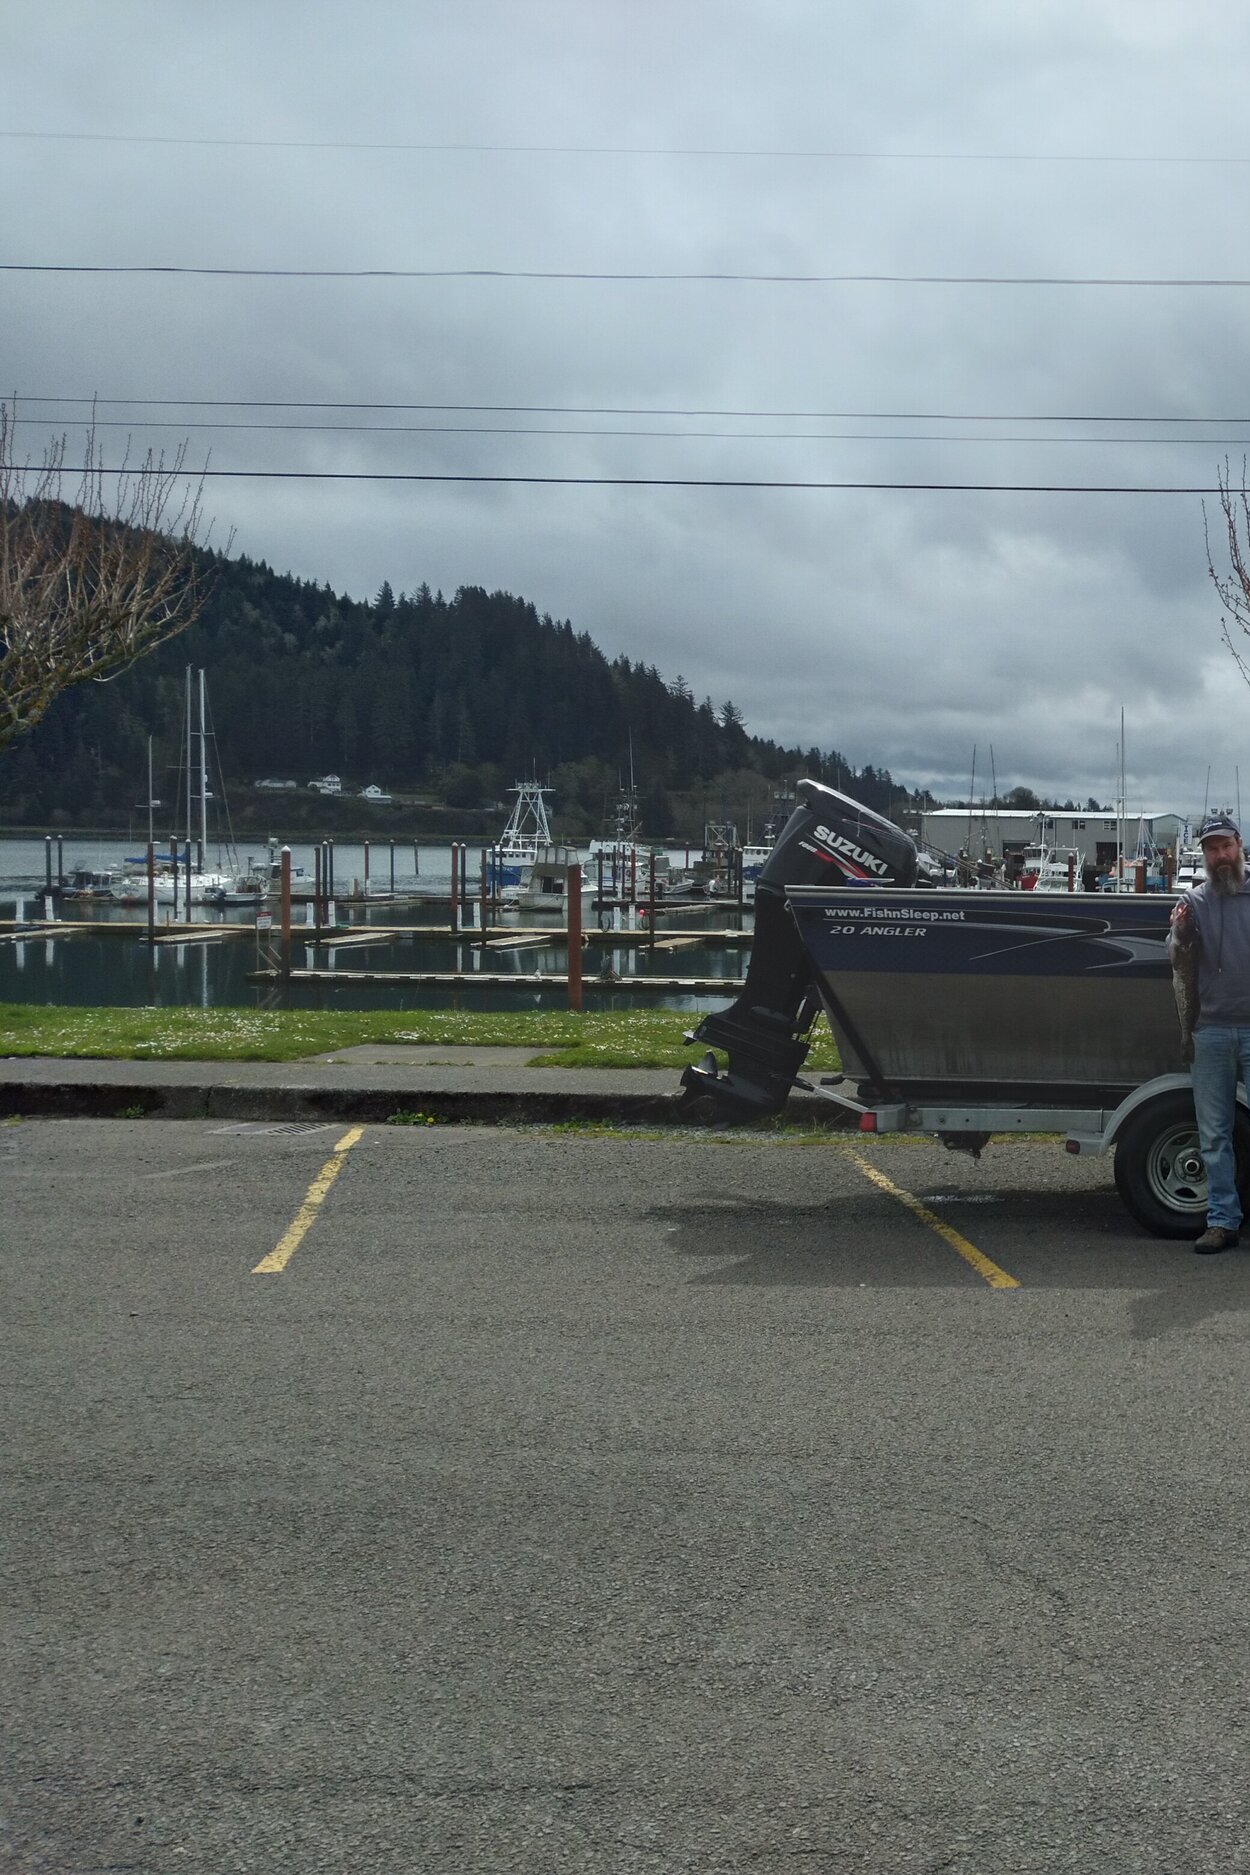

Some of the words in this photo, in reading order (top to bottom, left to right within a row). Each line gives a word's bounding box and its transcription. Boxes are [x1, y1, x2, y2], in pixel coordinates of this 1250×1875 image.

[814, 825, 889, 875] SUZUKI
[825, 907, 965, 921] www.FishnSleep.net
[830, 925, 855, 935] 20
[860, 925, 927, 937] ANGLER
